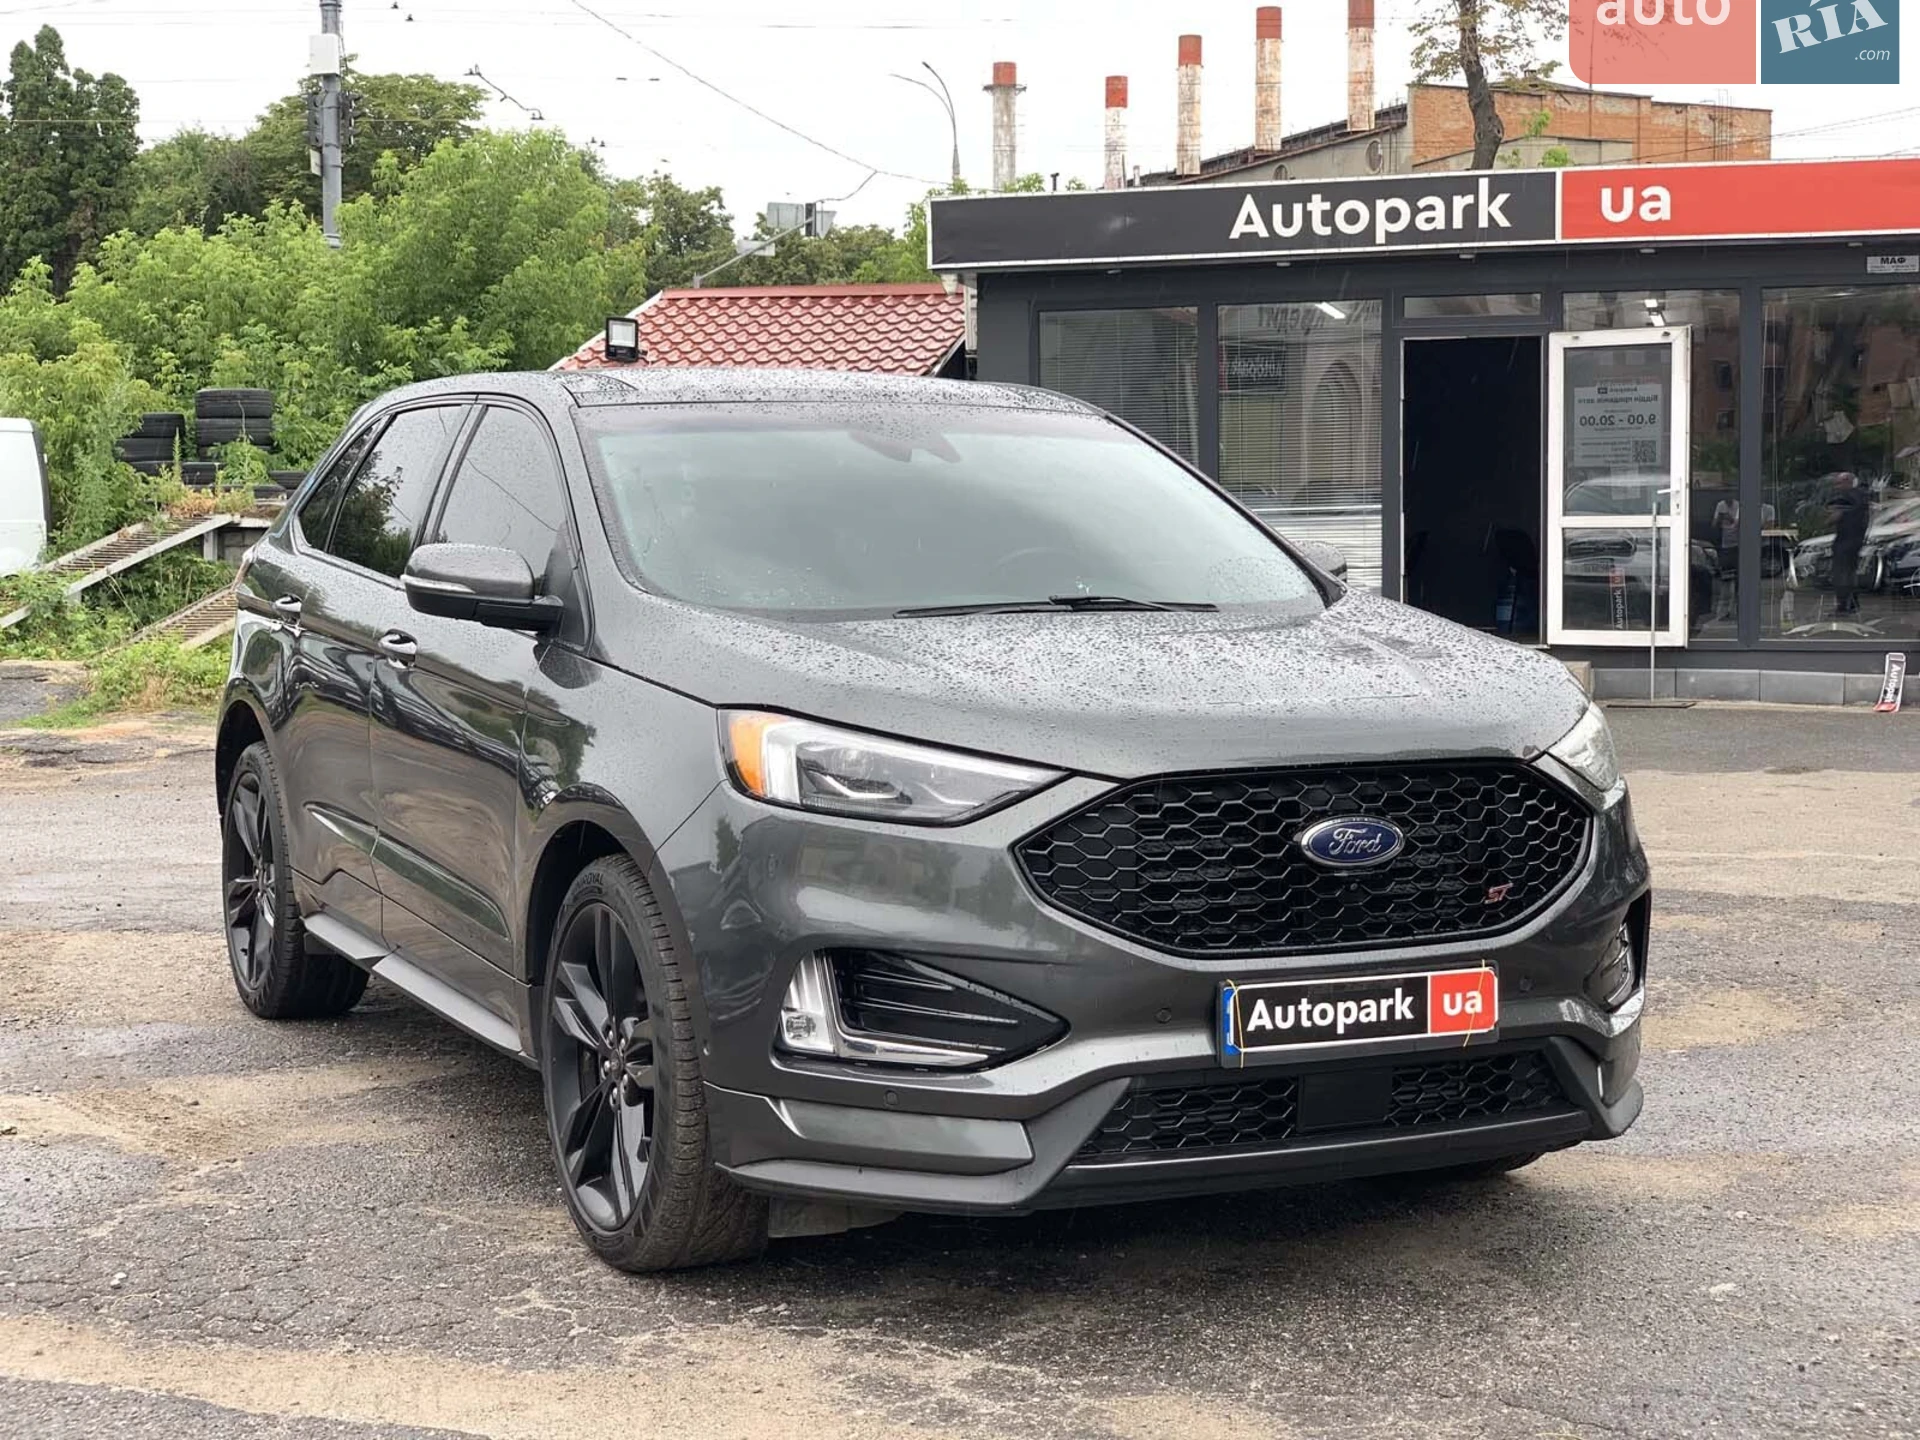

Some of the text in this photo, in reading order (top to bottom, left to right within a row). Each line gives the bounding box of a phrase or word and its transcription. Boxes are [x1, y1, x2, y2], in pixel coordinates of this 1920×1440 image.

[1229, 177, 1671, 245] Autopark ua
[1328, 827, 1382, 855] Ford
[1246, 987, 1483, 1034] Autopark ua
